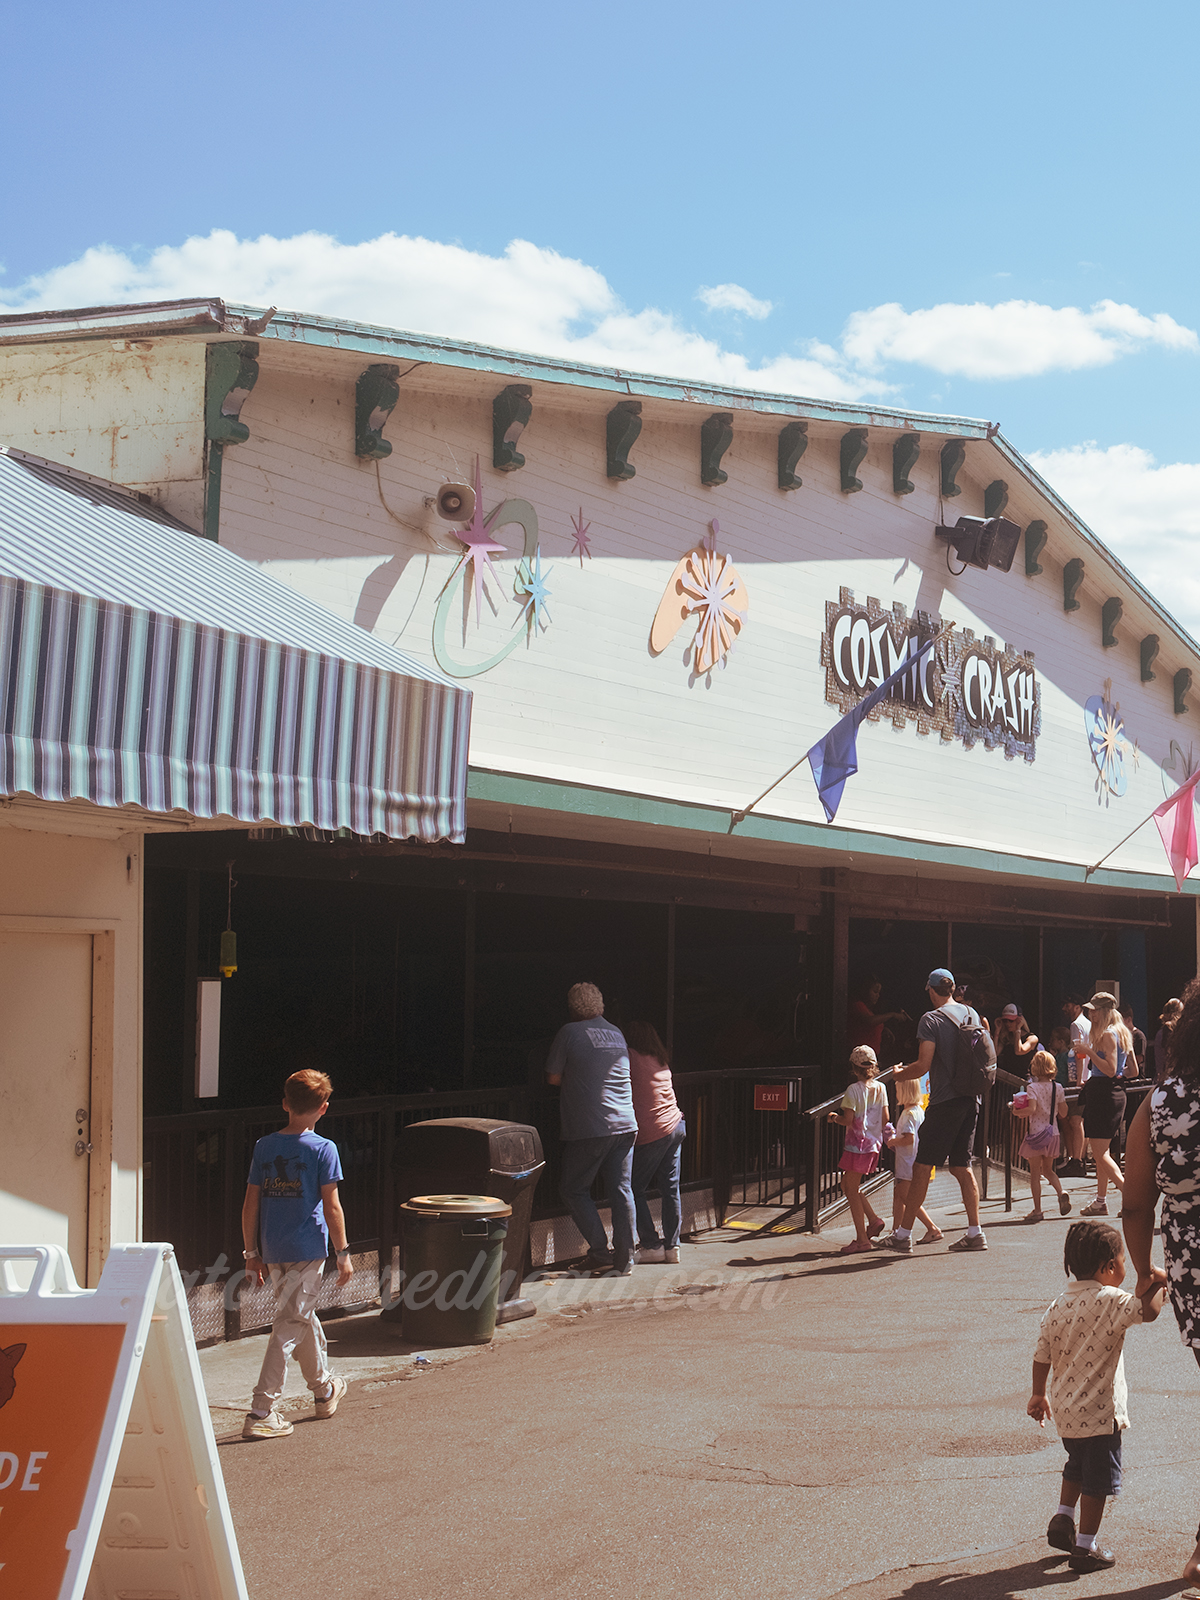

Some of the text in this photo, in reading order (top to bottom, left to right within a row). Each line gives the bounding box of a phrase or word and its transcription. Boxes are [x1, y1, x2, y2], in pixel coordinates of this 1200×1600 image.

[833, 614, 1035, 738] COSMIC CRASH
[762, 1093, 780, 1102] EXIT
